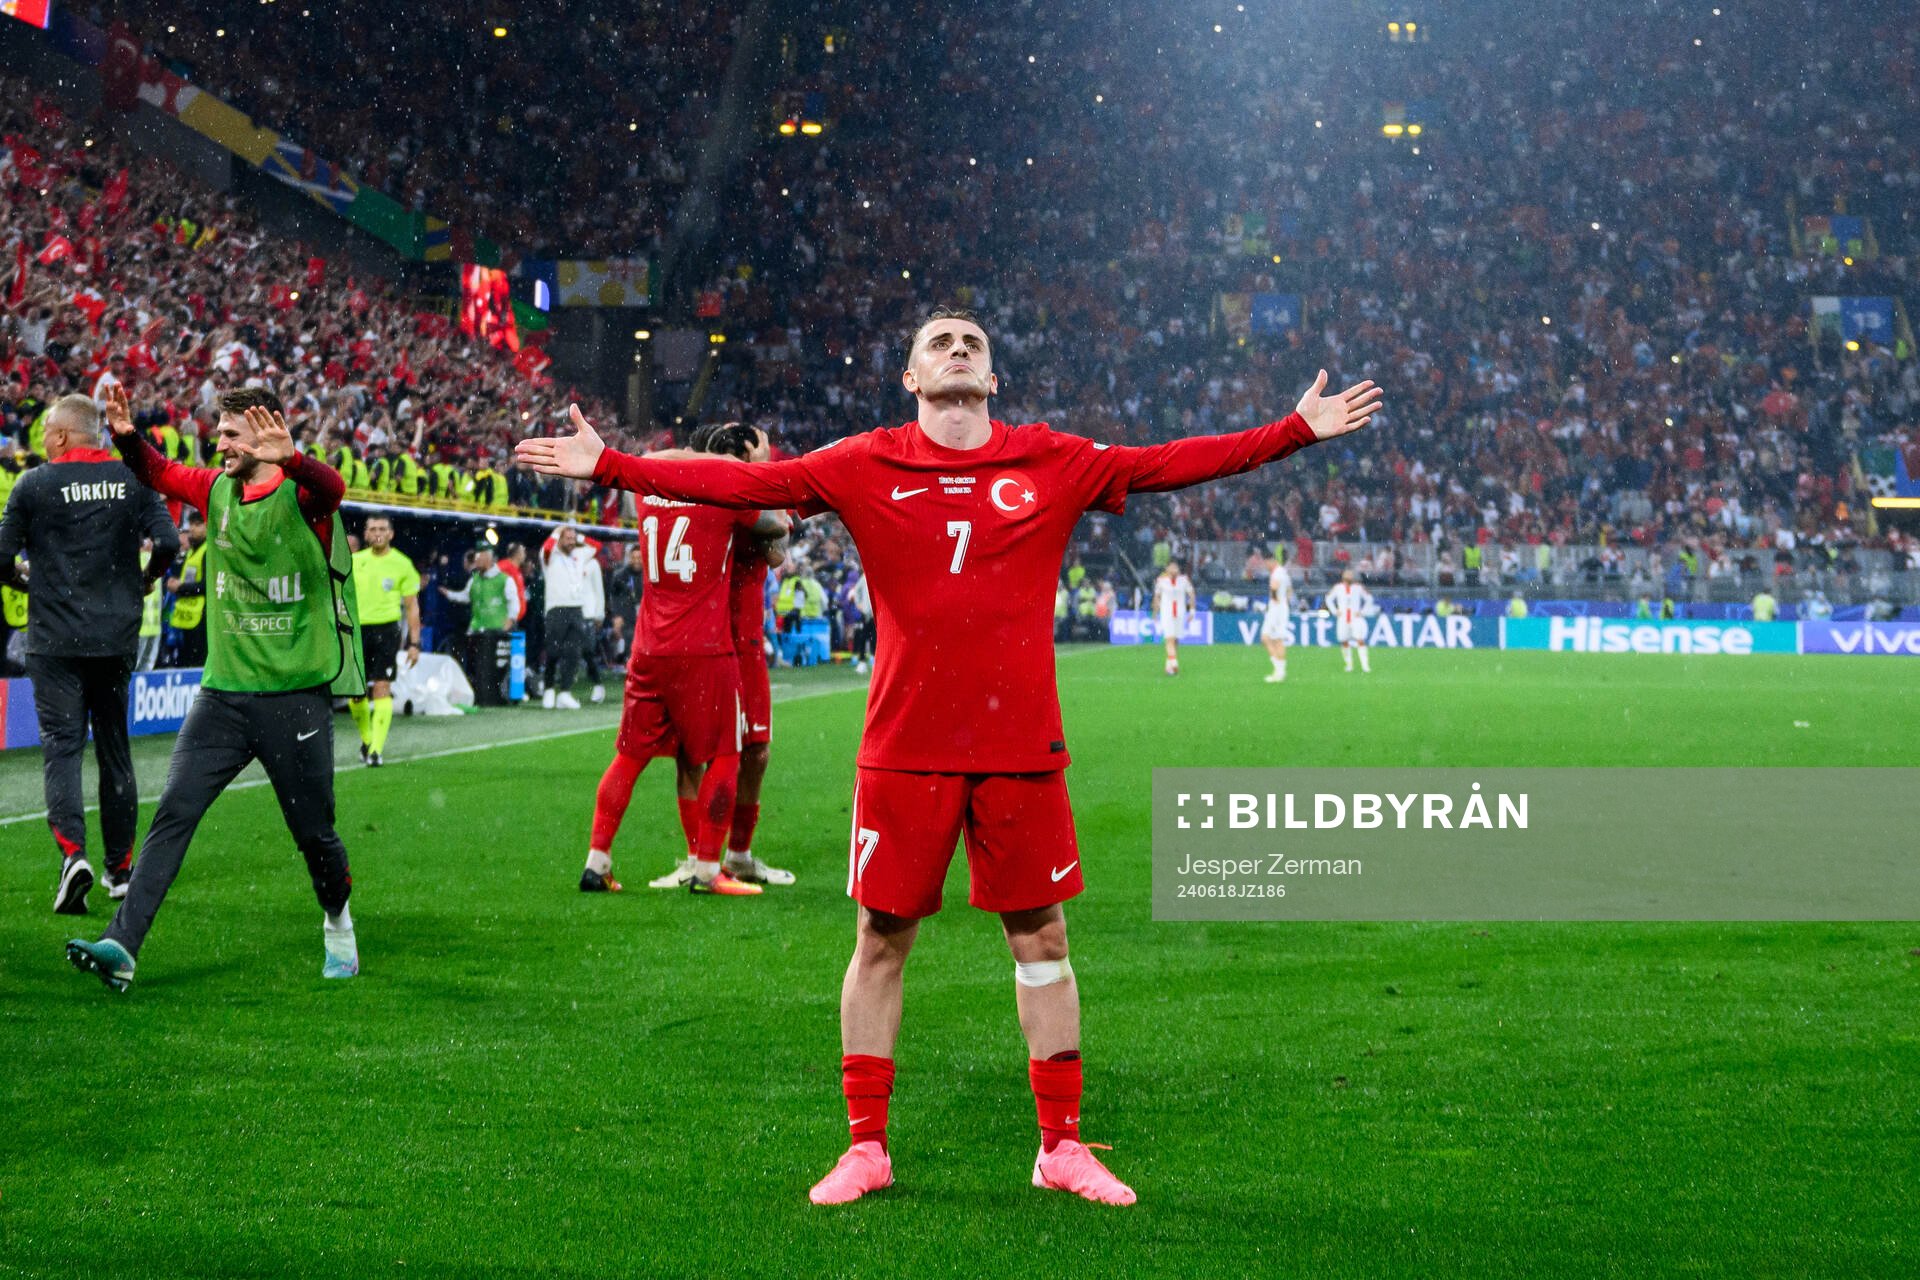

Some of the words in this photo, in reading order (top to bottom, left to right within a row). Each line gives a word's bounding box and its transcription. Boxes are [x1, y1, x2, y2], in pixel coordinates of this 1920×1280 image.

[61, 480, 126, 503] TÜRKİYE
[642, 516, 697, 583] 14
[946, 520, 972, 574] 7
[1237, 614, 1333, 648] vsit
[1341, 612, 1474, 649] ATAR
[1549, 615, 1754, 655] Hisense
[857, 827, 880, 883] 7
